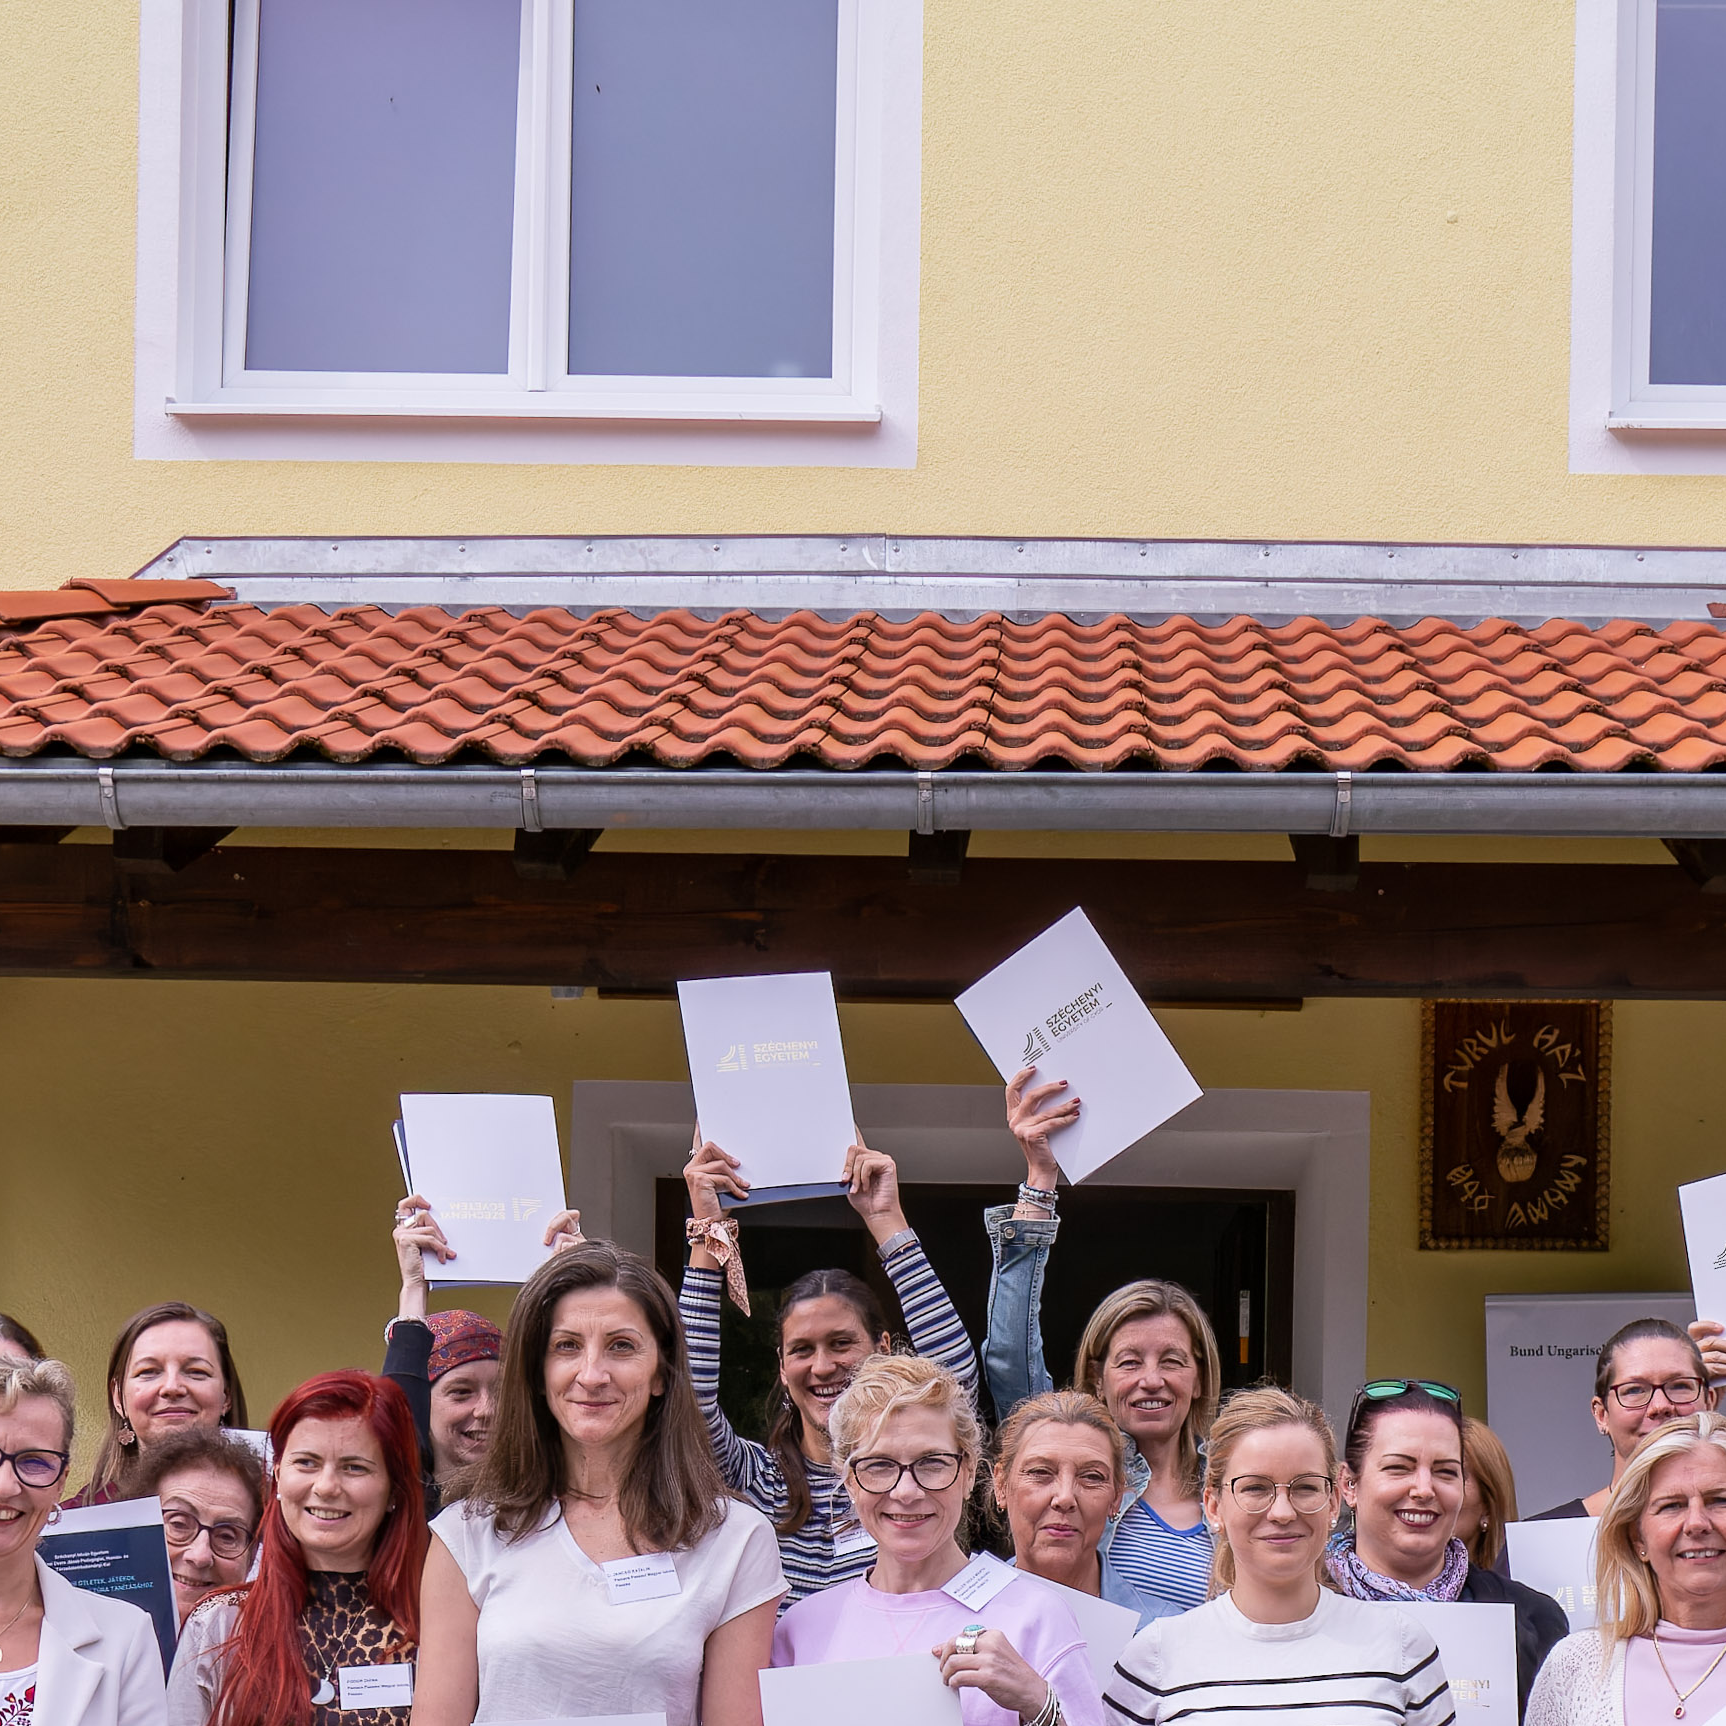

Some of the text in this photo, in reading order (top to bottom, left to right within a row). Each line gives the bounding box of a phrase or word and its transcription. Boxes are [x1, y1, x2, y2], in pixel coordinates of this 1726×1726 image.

[1045, 982, 1103, 1028] SZÉCHENYI
[1050, 998, 1101, 1037] EGYETEM
[753, 1039, 818, 1052] SZÉCHENYI
[754, 1050, 809, 1063] EGYETEM
[1443, 1019, 1586, 1092] TURUL HÁZ
[1510, 1344, 1605, 1359] Bund Ungarisc
[1450, 1680, 1490, 1689] HENYI
